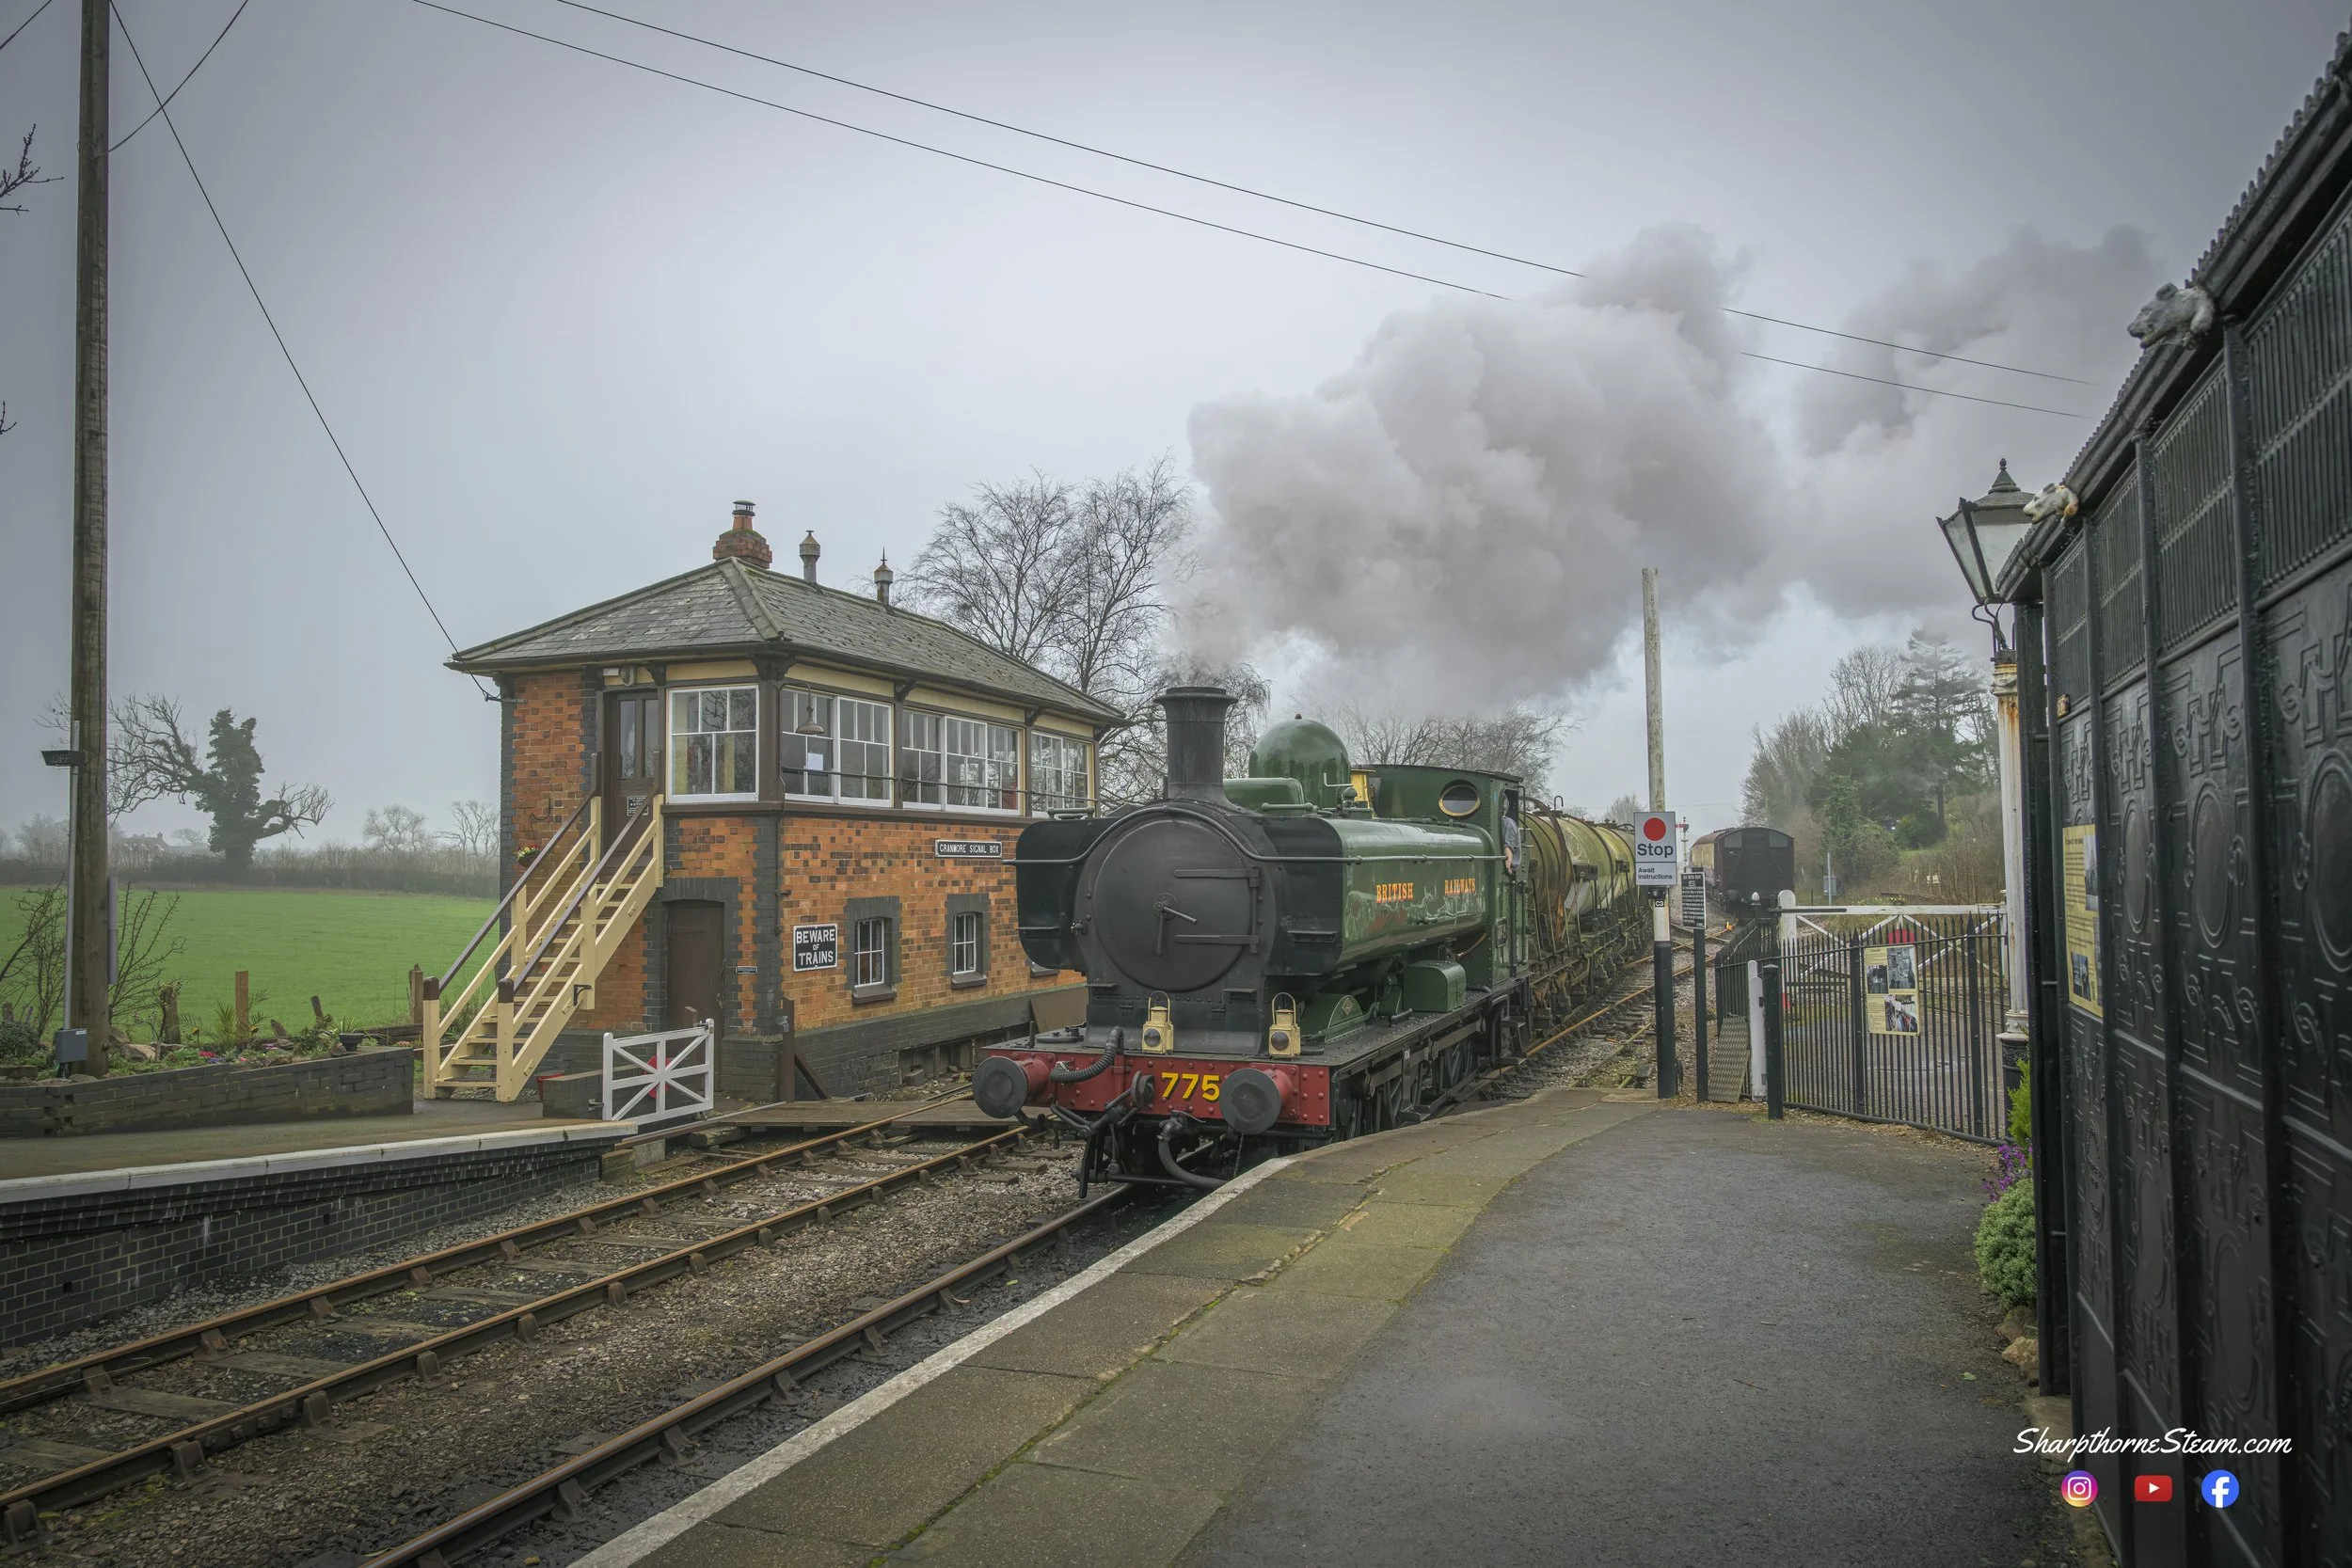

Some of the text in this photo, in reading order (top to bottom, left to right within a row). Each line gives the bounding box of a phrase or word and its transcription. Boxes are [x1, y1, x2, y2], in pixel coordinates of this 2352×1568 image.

[939, 844, 1000, 854] CRANMORE SIGNAL BOX
[1637, 843, 1674, 858] Stop
[1375, 878, 1476, 903] BRITISH RAILWAYS
[796, 928, 835, 944] BEWARE
[798, 950, 834, 966] TRAINS
